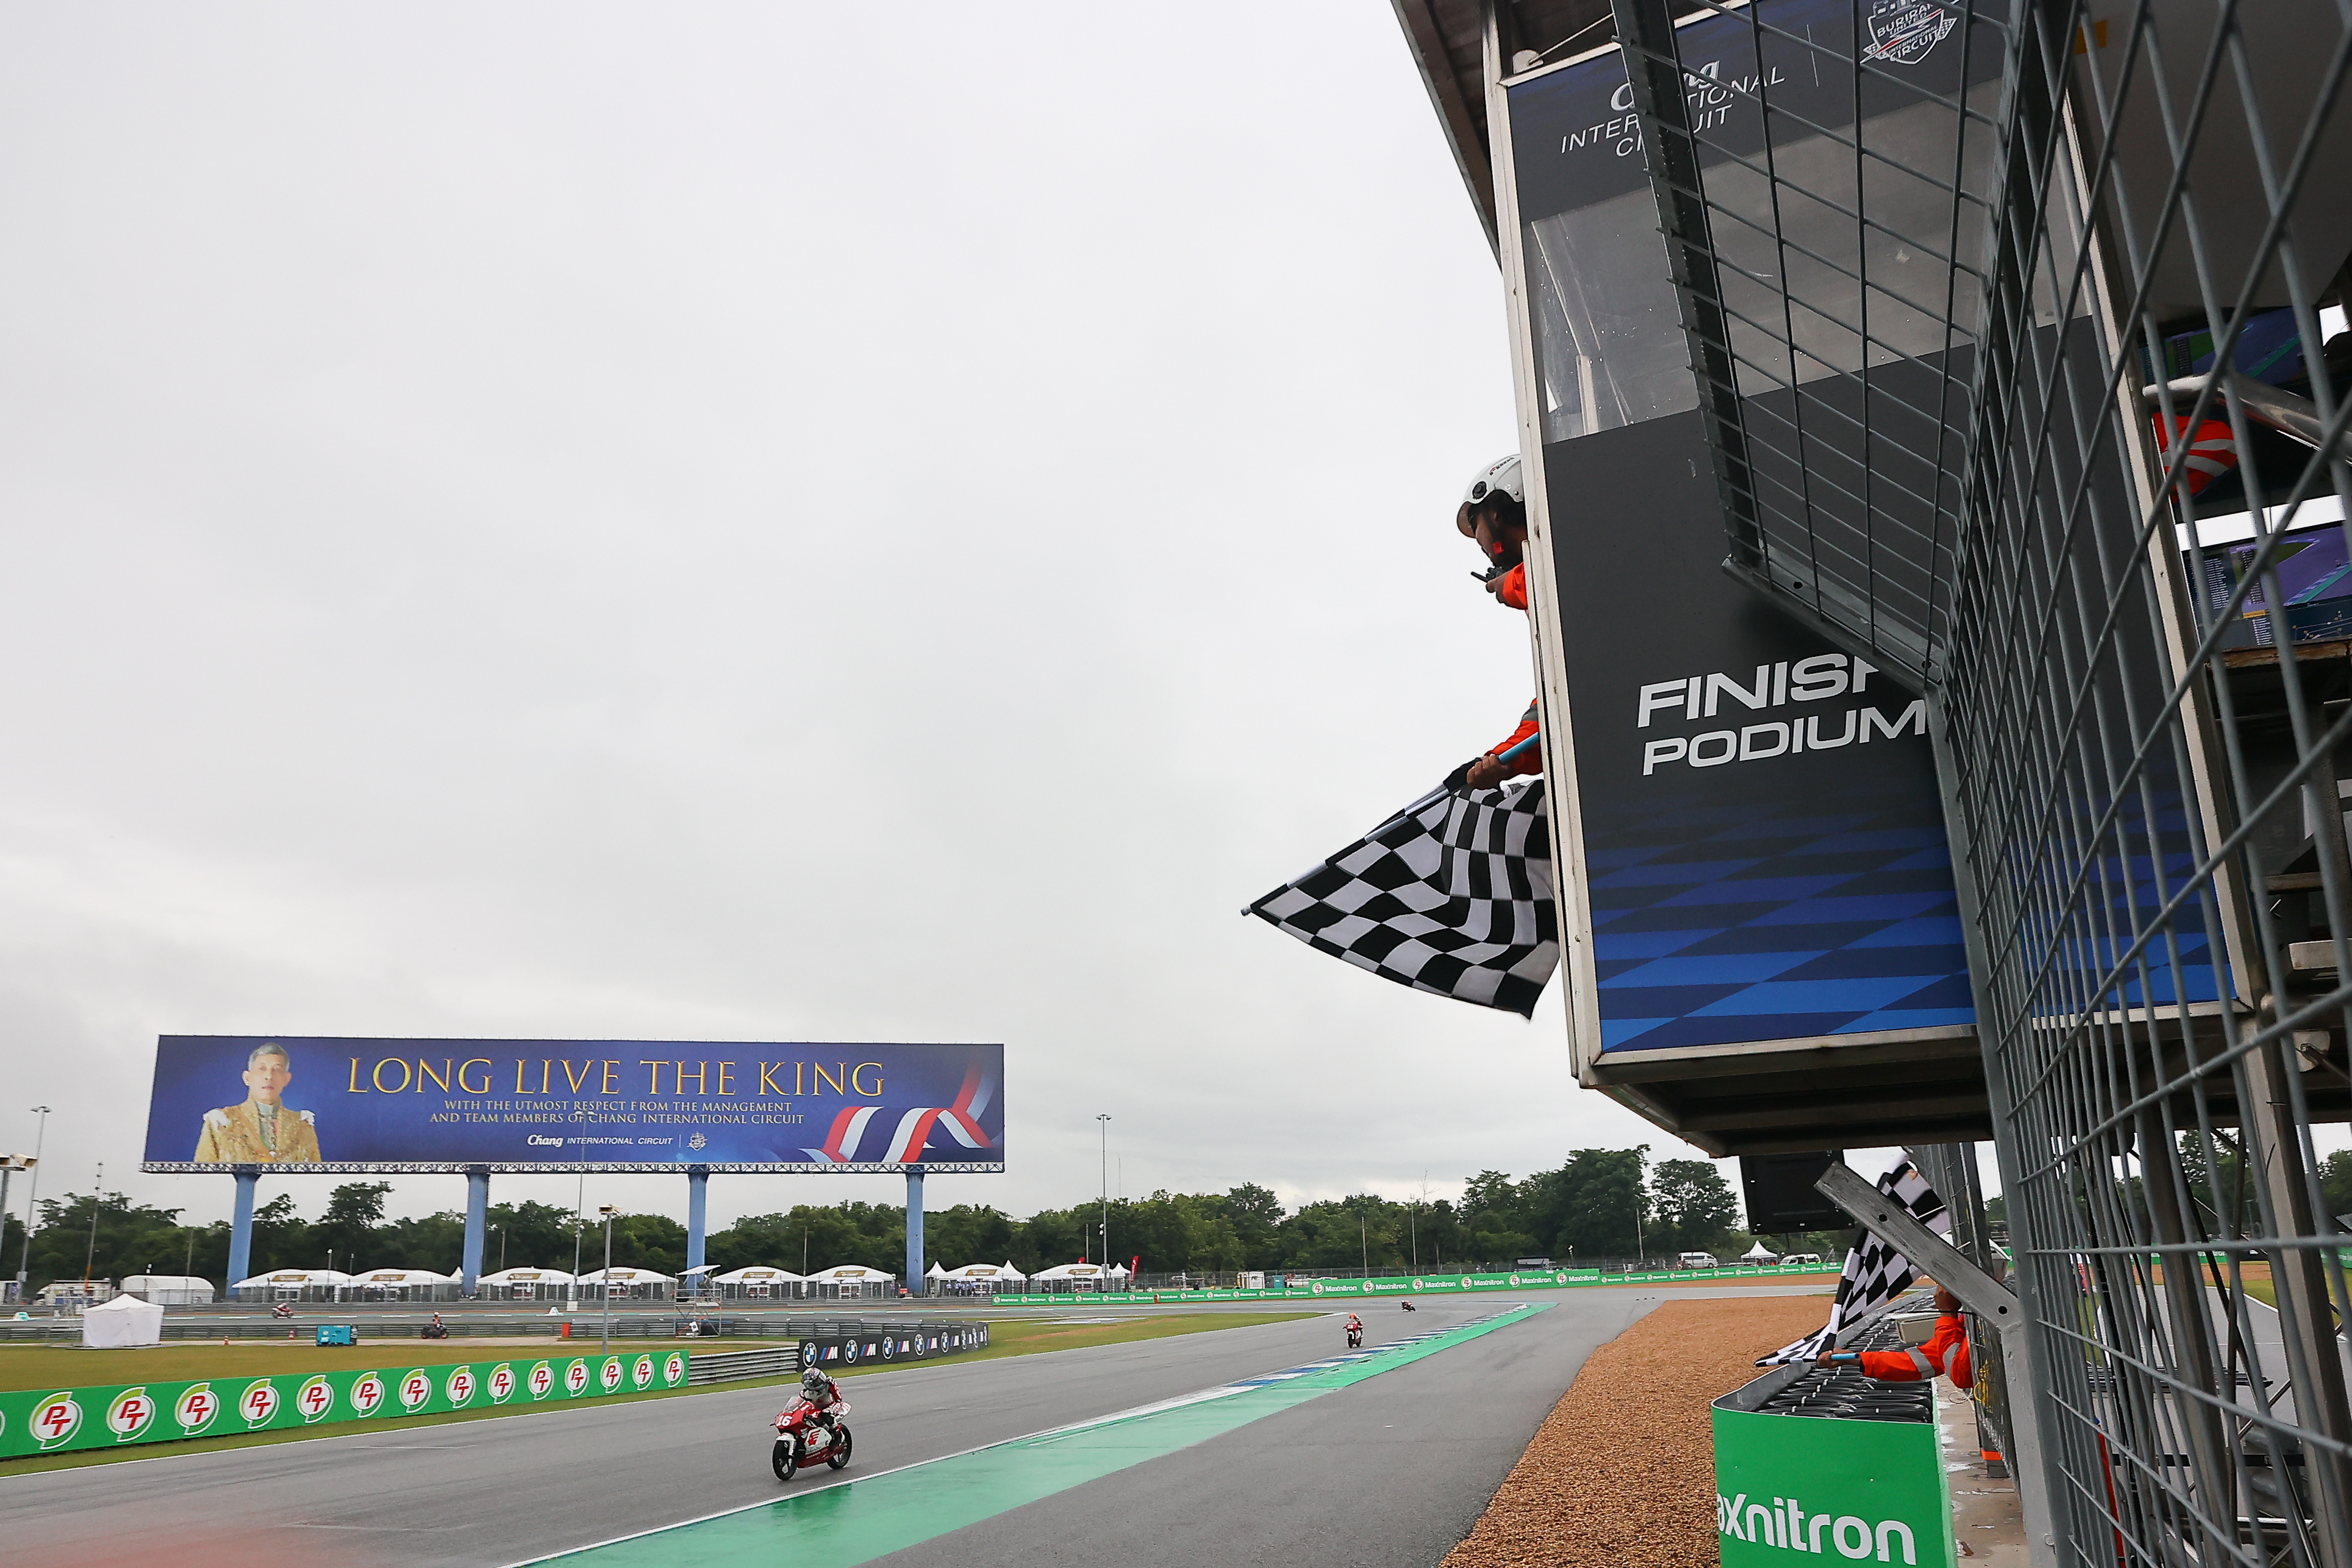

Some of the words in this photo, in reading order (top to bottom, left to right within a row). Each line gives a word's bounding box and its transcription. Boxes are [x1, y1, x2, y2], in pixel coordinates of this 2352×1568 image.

[1890, 28, 1939, 61] CIRCUIT
[1642, 699, 1926, 776] PODIUM
[348, 1057, 493, 1094] LONG
[513, 1059, 621, 1095] LIVE
[639, 1059, 736, 1095] THE
[757, 1061, 884, 1097] KING
[444, 1099, 480, 1111] WITH
[485, 1100, 510, 1111] THE
[514, 1101, 569, 1111] UTMOST
[573, 1101, 626, 1111] RESPECT
[631, 1101, 669, 1111] FROM
[673, 1102, 697, 1112] THE
[701, 1101, 792, 1112] MANAGEMENT
[430, 1112, 460, 1123] AND
[463, 1113, 499, 1123] TEAM
[503, 1113, 564, 1124] MEMBERS
[567, 1113, 585, 1124] OF
[589, 1114, 637, 1124] CHANG
[643, 1114, 747, 1124] INTERNATIONAL
[751, 1114, 805, 1124] CIRCUIT
[527, 1134, 564, 1148] Chang
[567, 1137, 634, 1145] INTERNATIONAL
[638, 1137, 674, 1145] CIRCUIT
[42, 1406, 71, 1436] PT
[119, 1400, 145, 1429] PT
[186, 1395, 209, 1423] PT
[250, 1390, 271, 1417] PT
[306, 1386, 326, 1412] PT
[359, 1383, 377, 1406] PT
[407, 1379, 424, 1402] PT
[453, 1376, 469, 1398] PT
[495, 1373, 509, 1394] PT
[535, 1370, 549, 1390] PT
[572, 1368, 584, 1387] PT
[776, 1415, 793, 1427] 16
